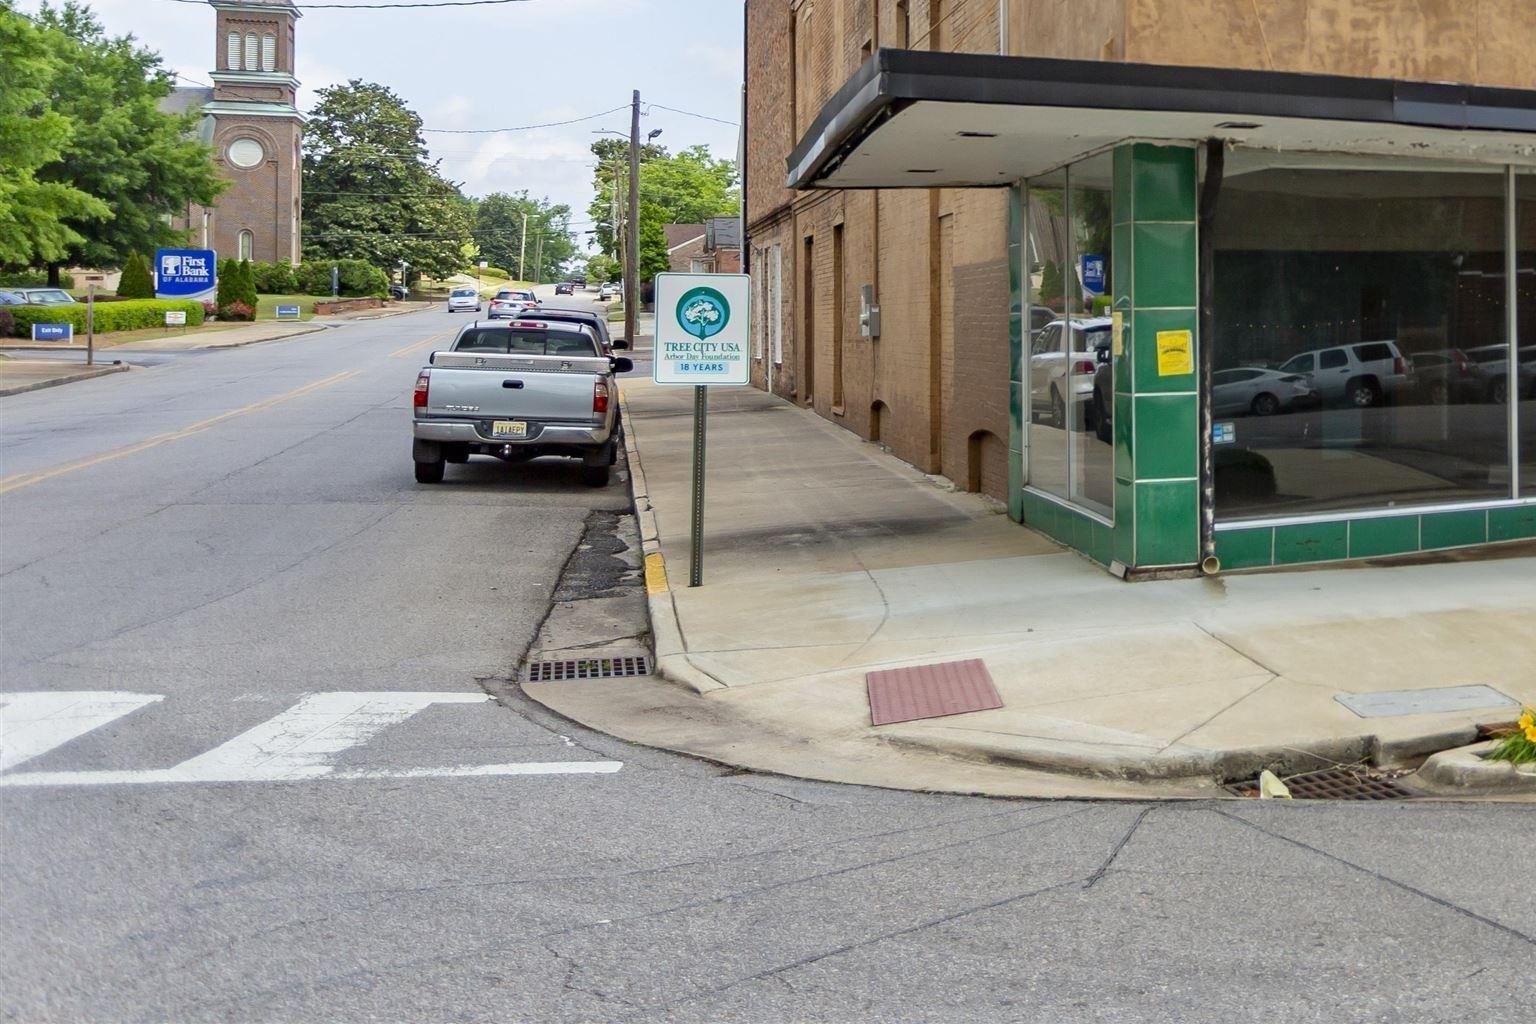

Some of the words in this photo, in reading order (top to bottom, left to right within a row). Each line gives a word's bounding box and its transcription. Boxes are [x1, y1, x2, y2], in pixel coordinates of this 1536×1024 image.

[182, 256, 206, 266] First
[182, 266, 210, 276] Bank
[664, 343, 692, 352] TREE
[693, 343, 719, 352] CITY
[721, 343, 740, 352] USA
[687, 353, 699, 361] Day
[702, 353, 740, 361] Foundation
[680, 363, 690, 371] 18
[693, 363, 724, 371] YEARS
